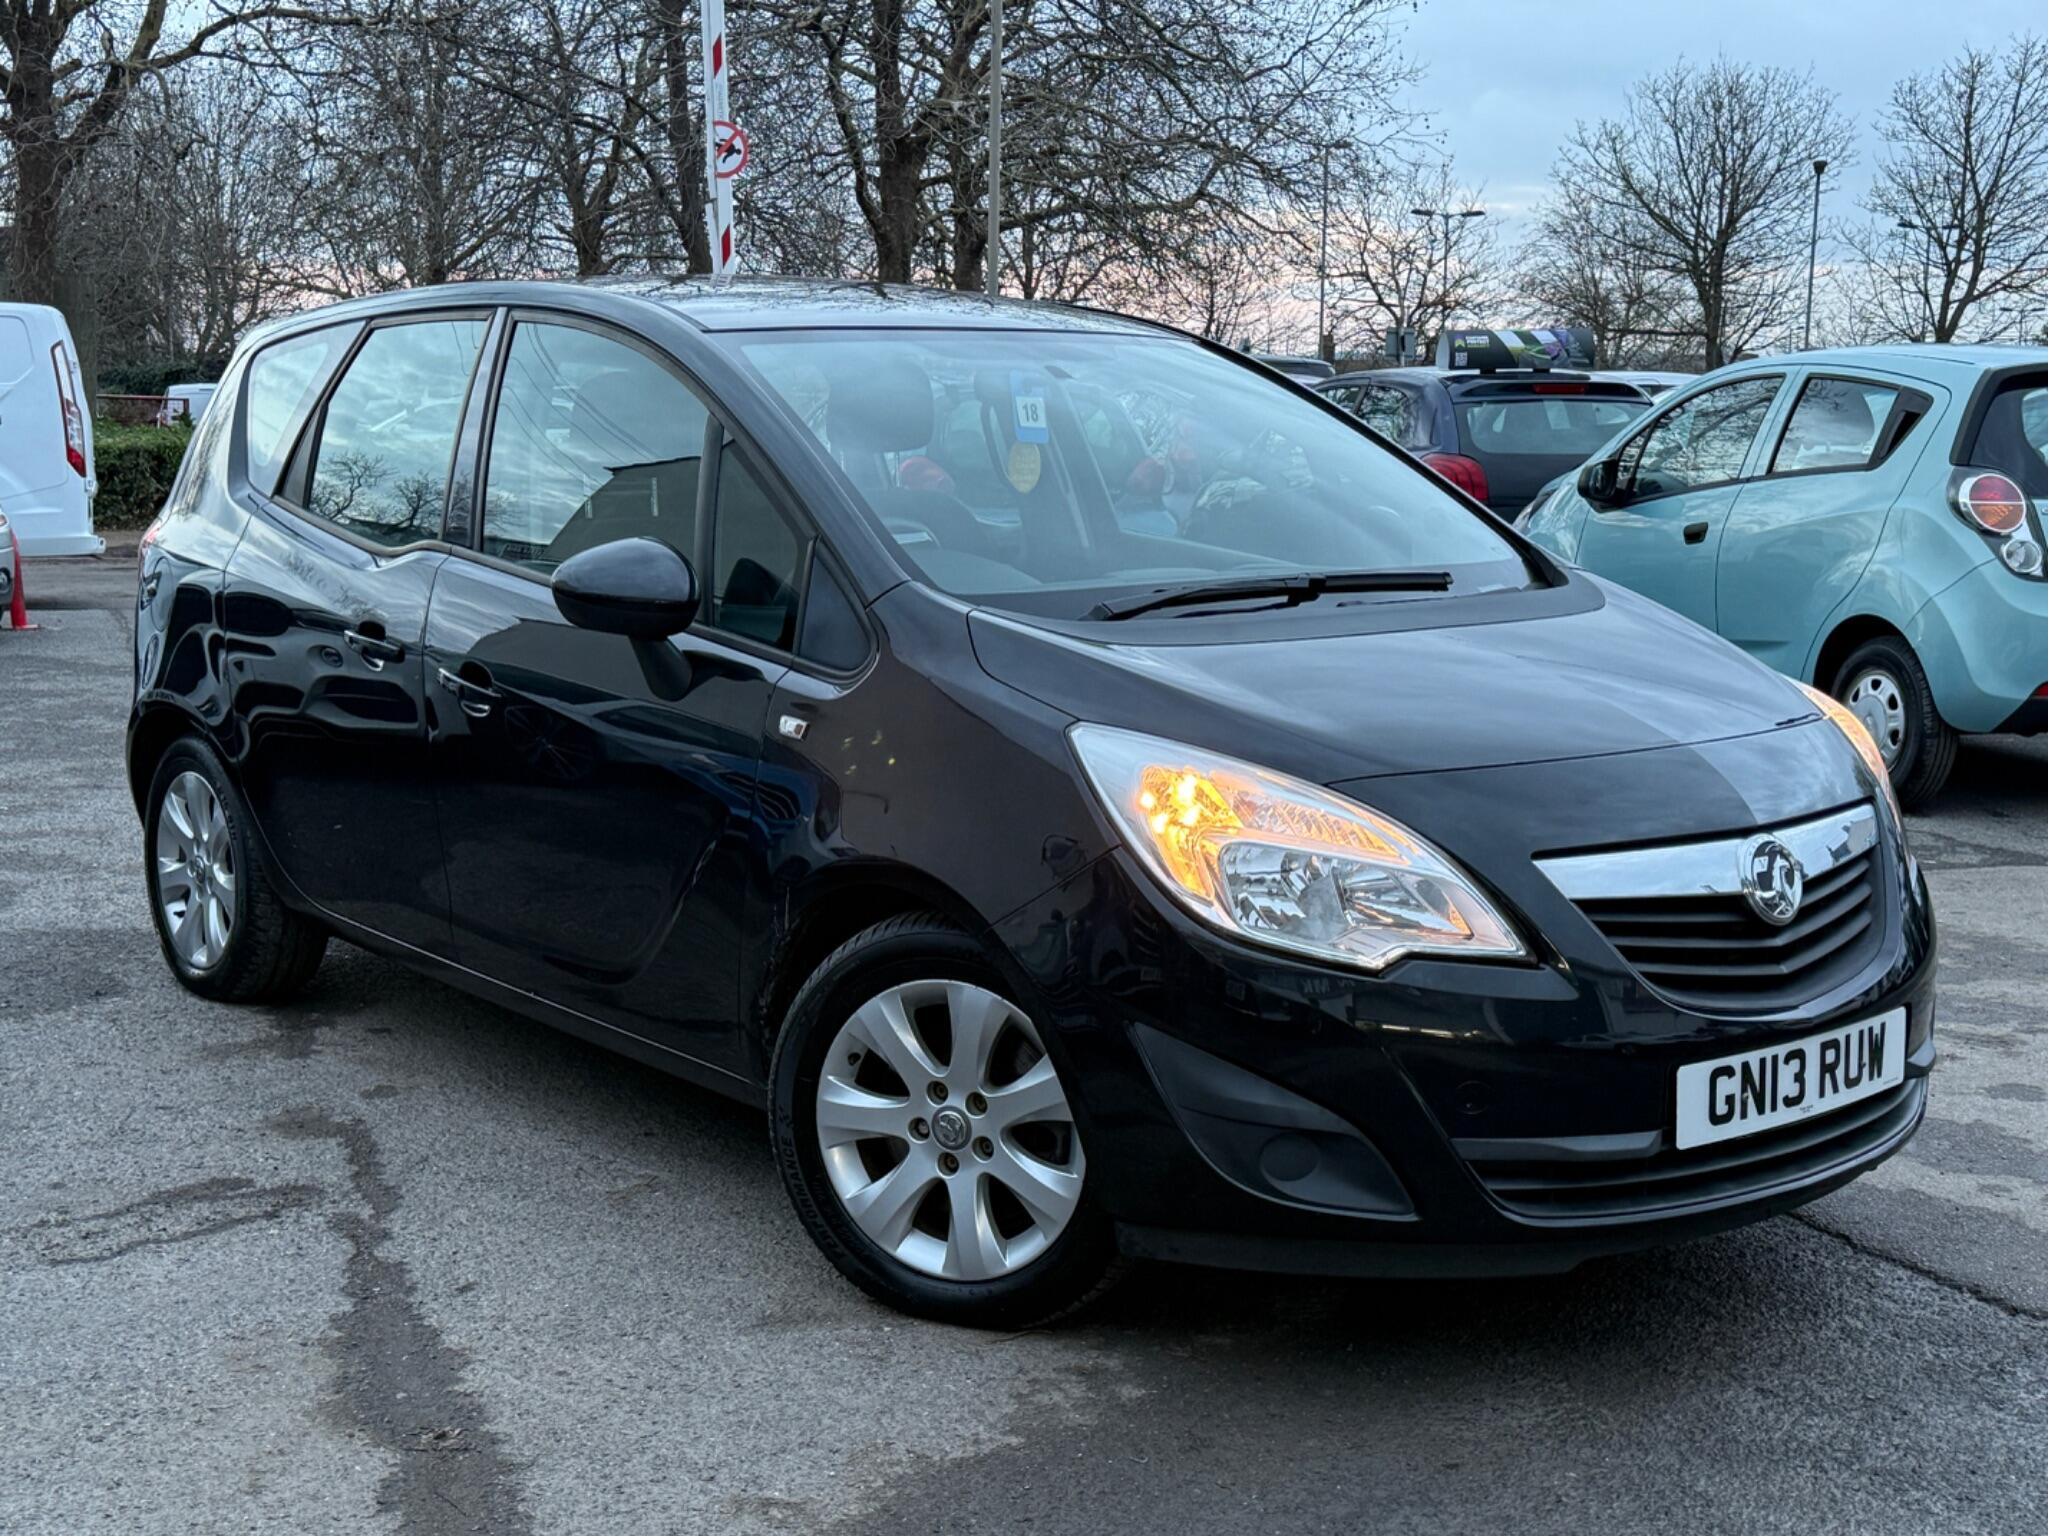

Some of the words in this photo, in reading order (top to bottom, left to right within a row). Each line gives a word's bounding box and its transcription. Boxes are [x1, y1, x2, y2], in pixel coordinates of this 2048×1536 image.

[1022, 403, 1039, 422] 18
[1708, 1047, 1807, 1126] GN13
[1818, 1021, 1887, 1099] RUW
